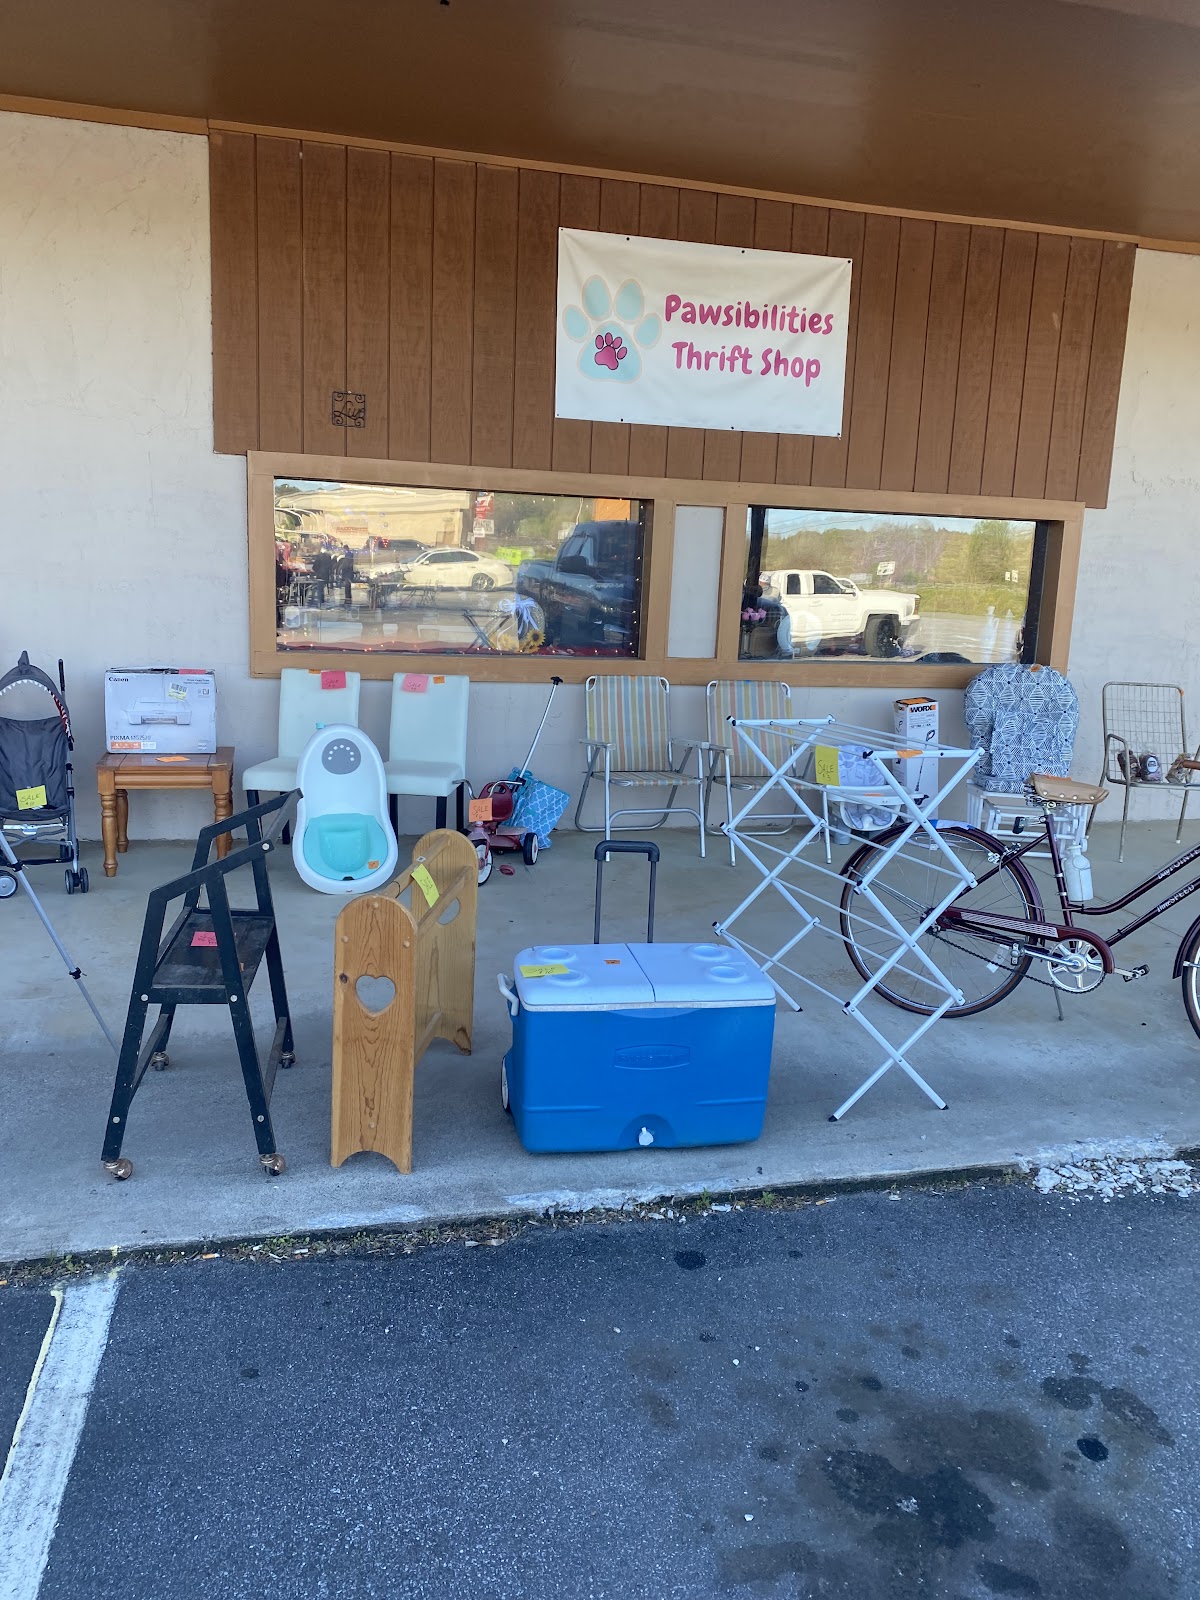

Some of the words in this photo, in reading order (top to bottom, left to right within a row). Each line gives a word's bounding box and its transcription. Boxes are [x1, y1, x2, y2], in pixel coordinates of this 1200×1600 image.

[665, 294, 834, 335] Pawsibilities
[671, 341, 753, 375] Thrift
[760, 347, 821, 387] Shop
[911, 705, 932, 713] WORX
[819, 759, 834, 775] SALE
[20, 794, 40, 802] SALE
[472, 805, 488, 815] SALE
